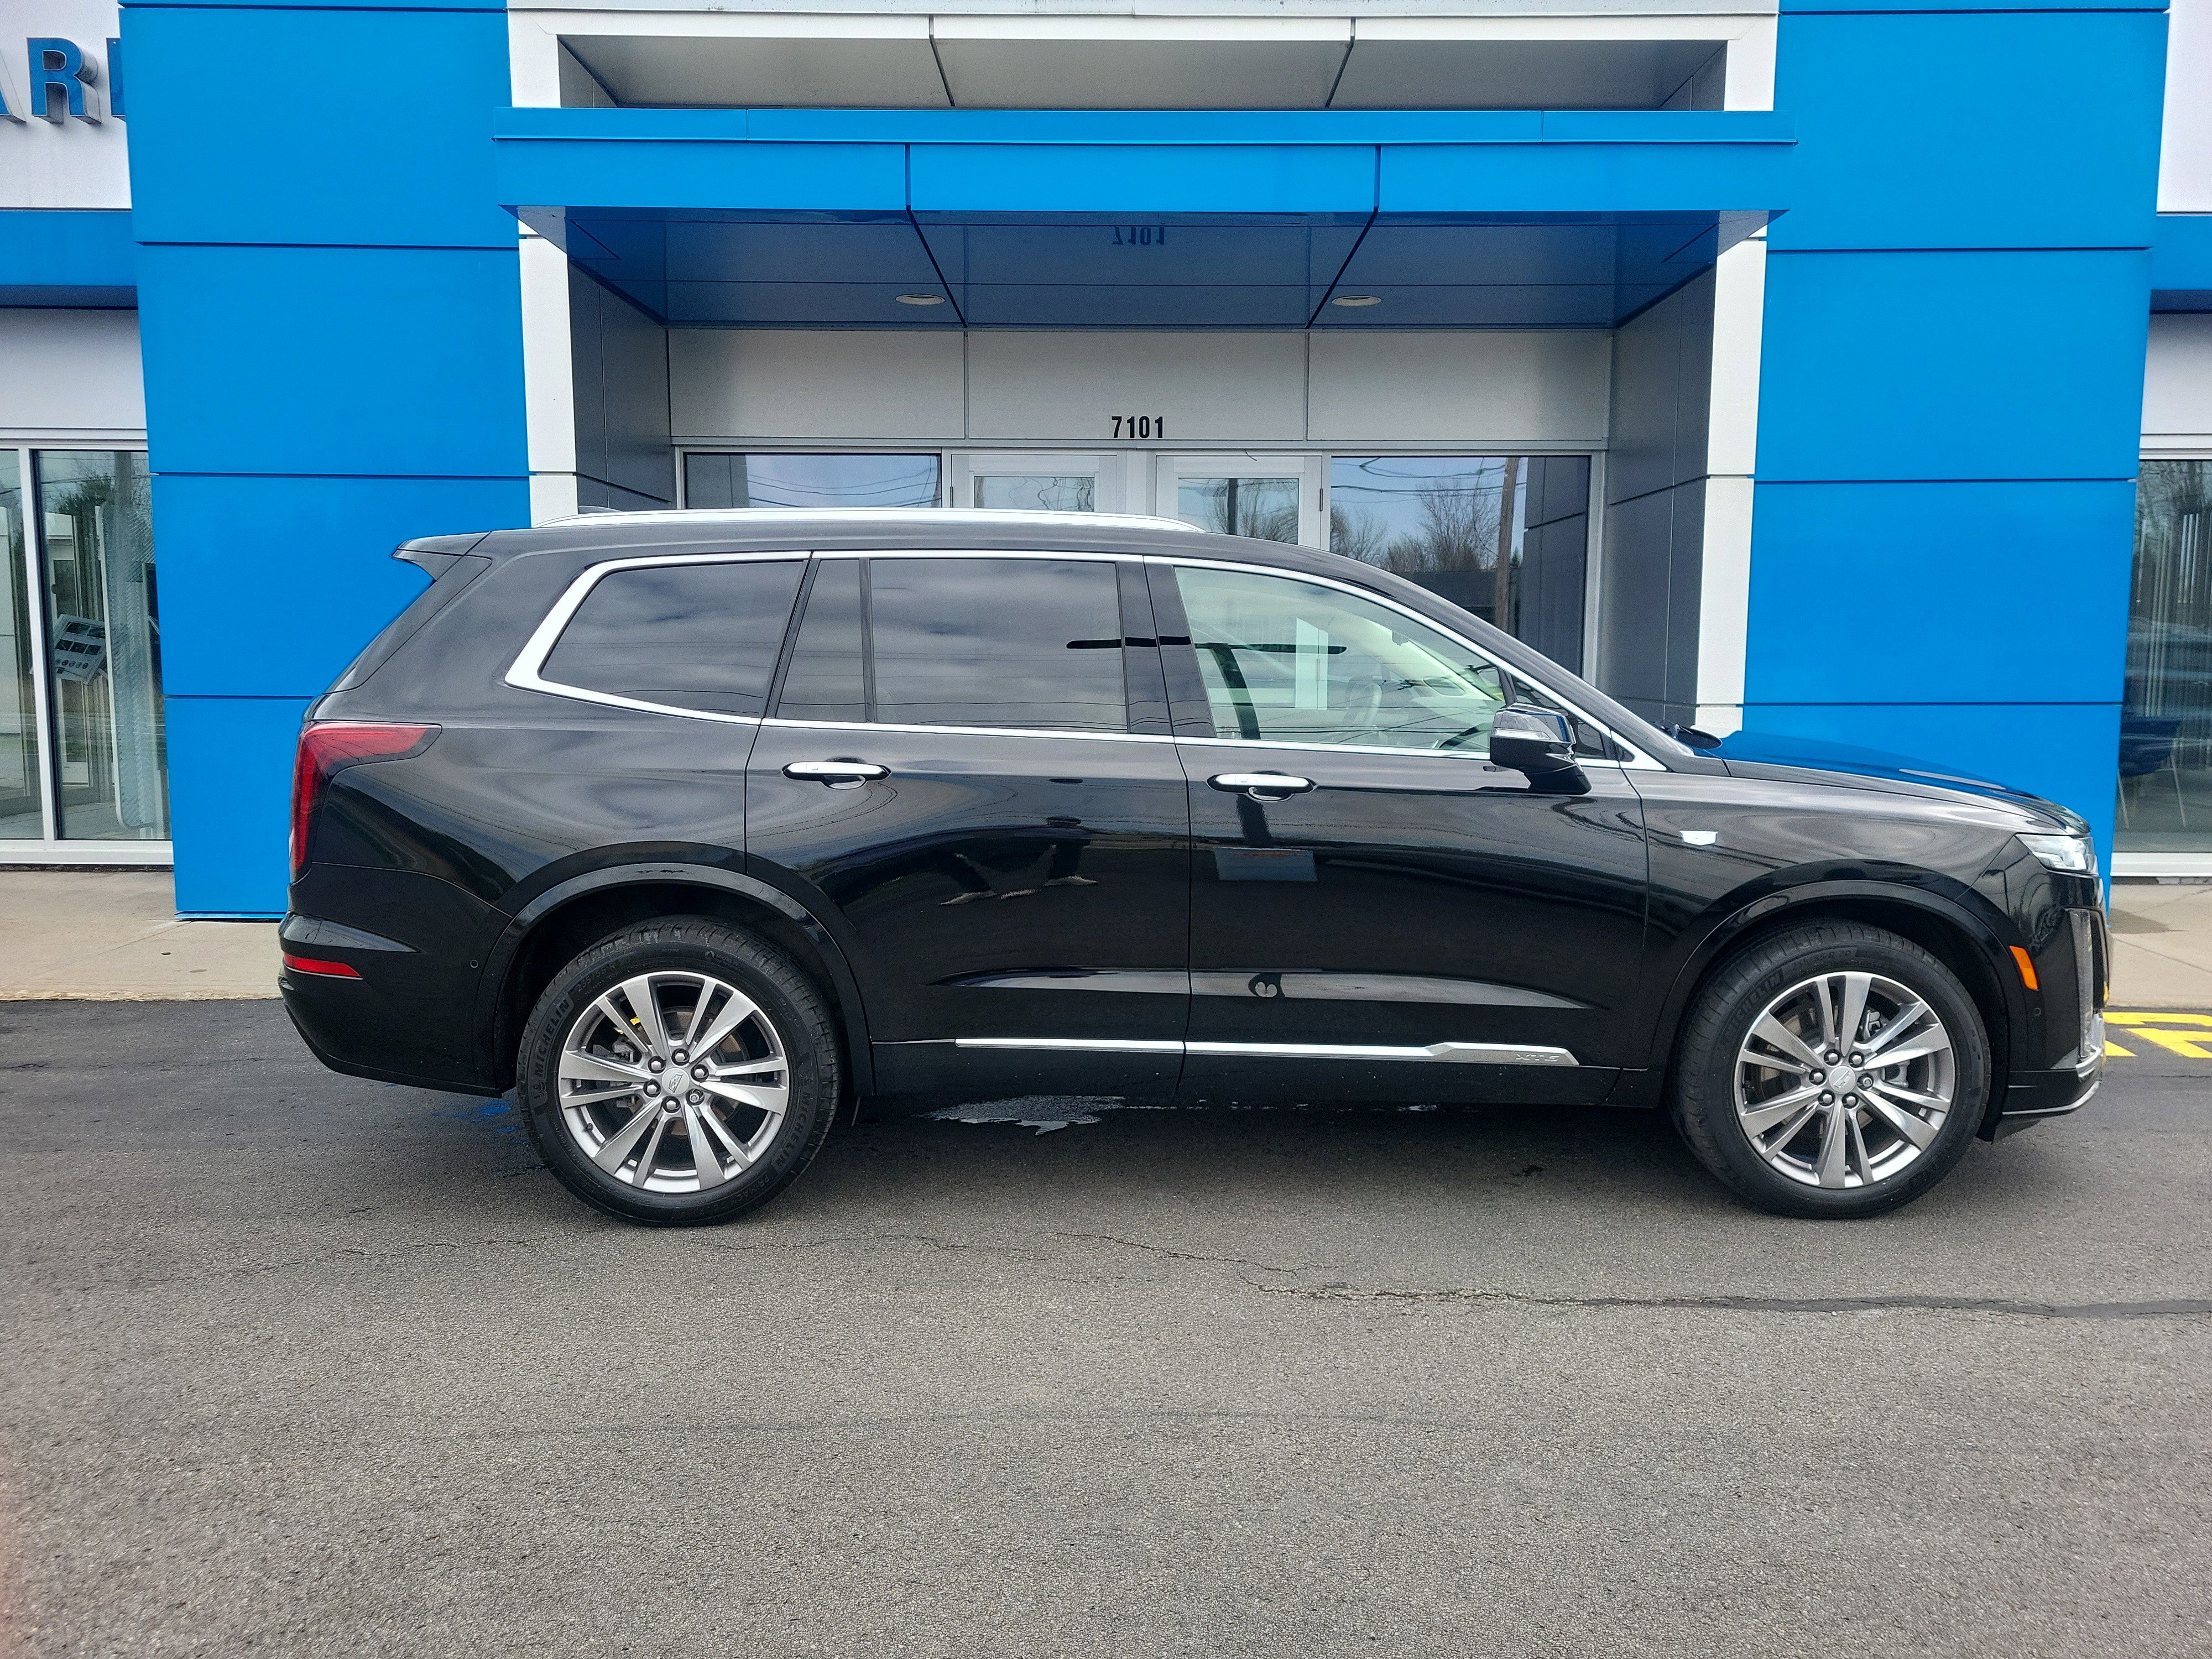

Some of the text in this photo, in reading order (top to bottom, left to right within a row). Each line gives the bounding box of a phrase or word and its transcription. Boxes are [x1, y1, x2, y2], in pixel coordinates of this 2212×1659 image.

[1111, 415, 1163, 439] 7101
[534, 999, 571, 1078] MICHELIN
[1723, 972, 1781, 1038] MICHELIN
[775, 1092, 812, 1167] MICHELIN
